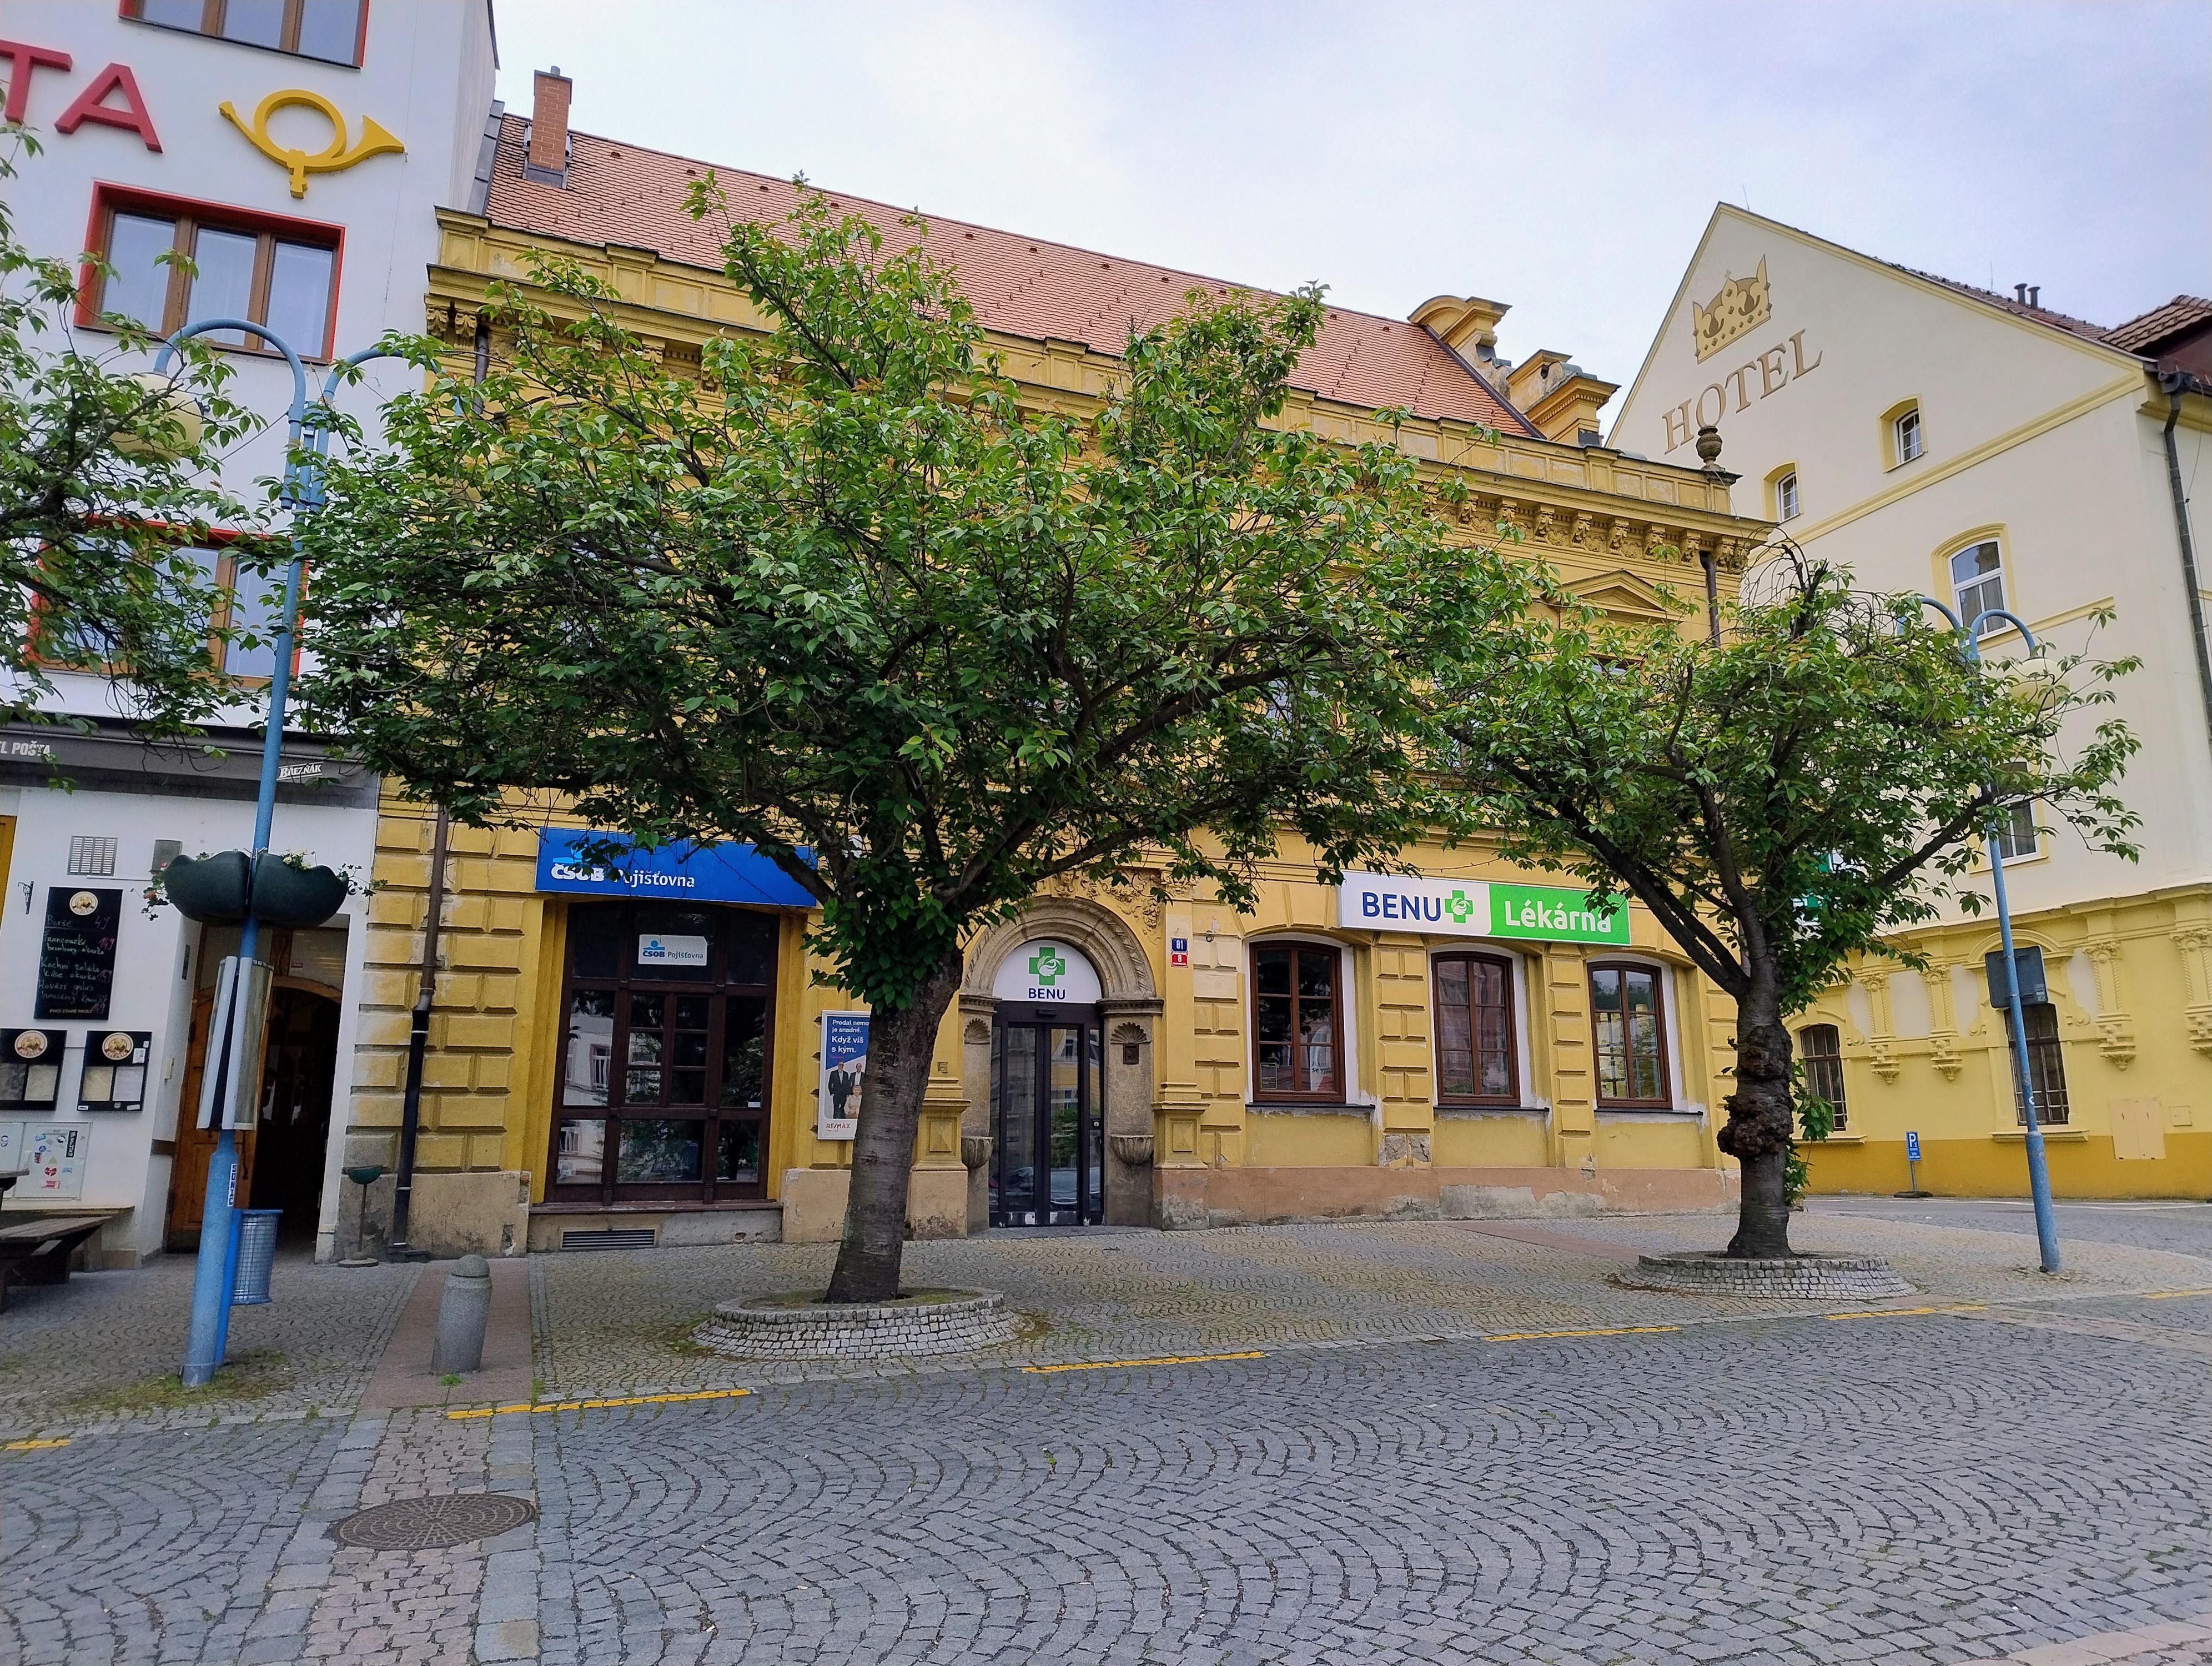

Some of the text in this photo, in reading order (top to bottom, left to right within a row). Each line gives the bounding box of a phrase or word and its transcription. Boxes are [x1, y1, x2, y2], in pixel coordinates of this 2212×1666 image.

[0, 39, 163, 153] TA
[1662, 328, 1822, 455] HOTEL
[1363, 892, 1611, 932] BENU Lékárna
[667, 951, 703, 960] Pojišťovna
[1028, 988, 1065, 1000] BENU
[832, 1036, 851, 1044] Když
[838, 1046, 857, 1054] kým.
[229, 1165, 237, 1205] SONIC
